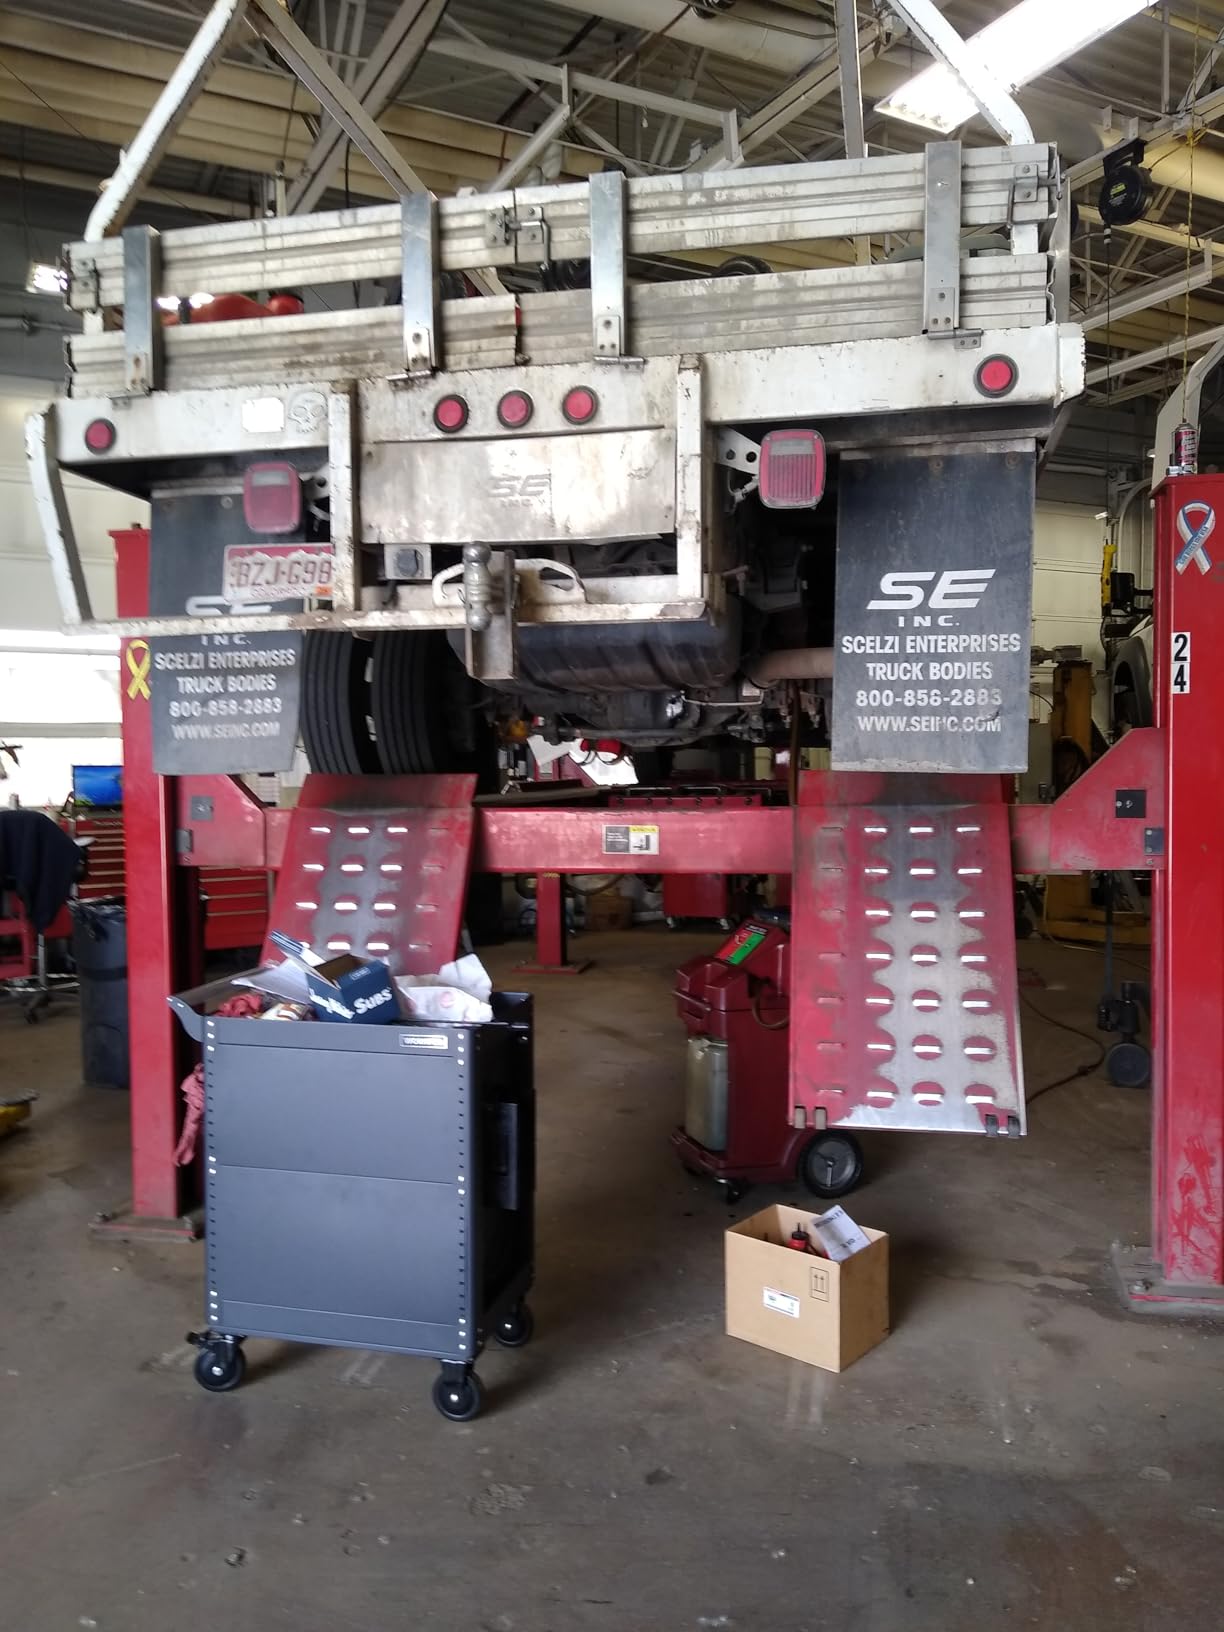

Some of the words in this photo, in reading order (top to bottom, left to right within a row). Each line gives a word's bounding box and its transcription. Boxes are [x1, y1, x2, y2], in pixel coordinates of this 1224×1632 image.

[866, 569, 996, 610] SE
[898, 615, 961, 627] INC.
[841, 635, 900, 654] SCELZI
[906, 633, 1022, 653] ENTERPRISES
[154, 651, 205, 671] SCELZI
[207, 648, 297, 670] ENTERPRISES
[866, 662, 924, 681] TRUCK
[929, 661, 993, 680] BODIES
[176, 675, 225, 695] TRUCK
[227, 673, 277, 693] BODIES
